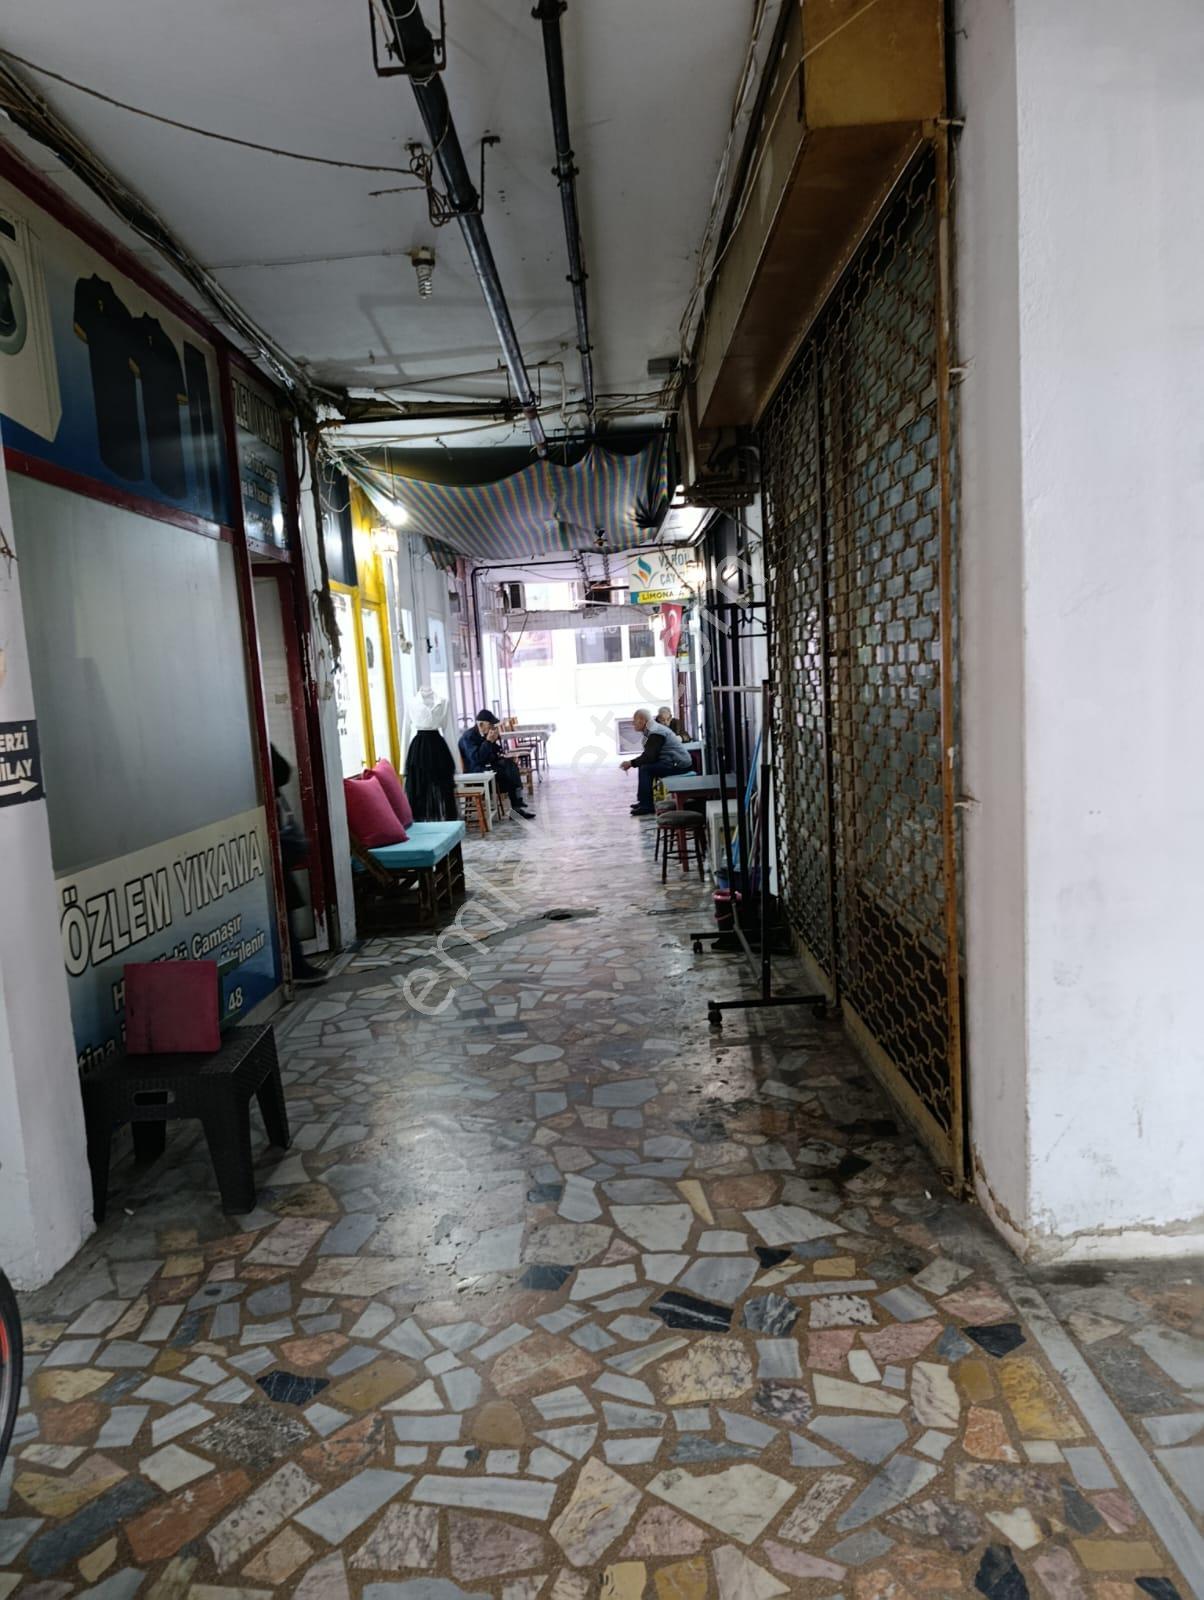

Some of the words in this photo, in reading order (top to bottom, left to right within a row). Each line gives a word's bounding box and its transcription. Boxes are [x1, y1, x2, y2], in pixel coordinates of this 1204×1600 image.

[641, 590, 685, 601] LİMONAA
[0, 725, 29, 753] ERZİ
[0, 757, 33, 782] İLAY
[60, 867, 172, 977] ÖZLEM
[173, 829, 264, 916] YIKAMA
[191, 914, 242, 961] Çamaşır
[227, 985, 244, 1011] 48
[78, 1039, 117, 1073] tina
